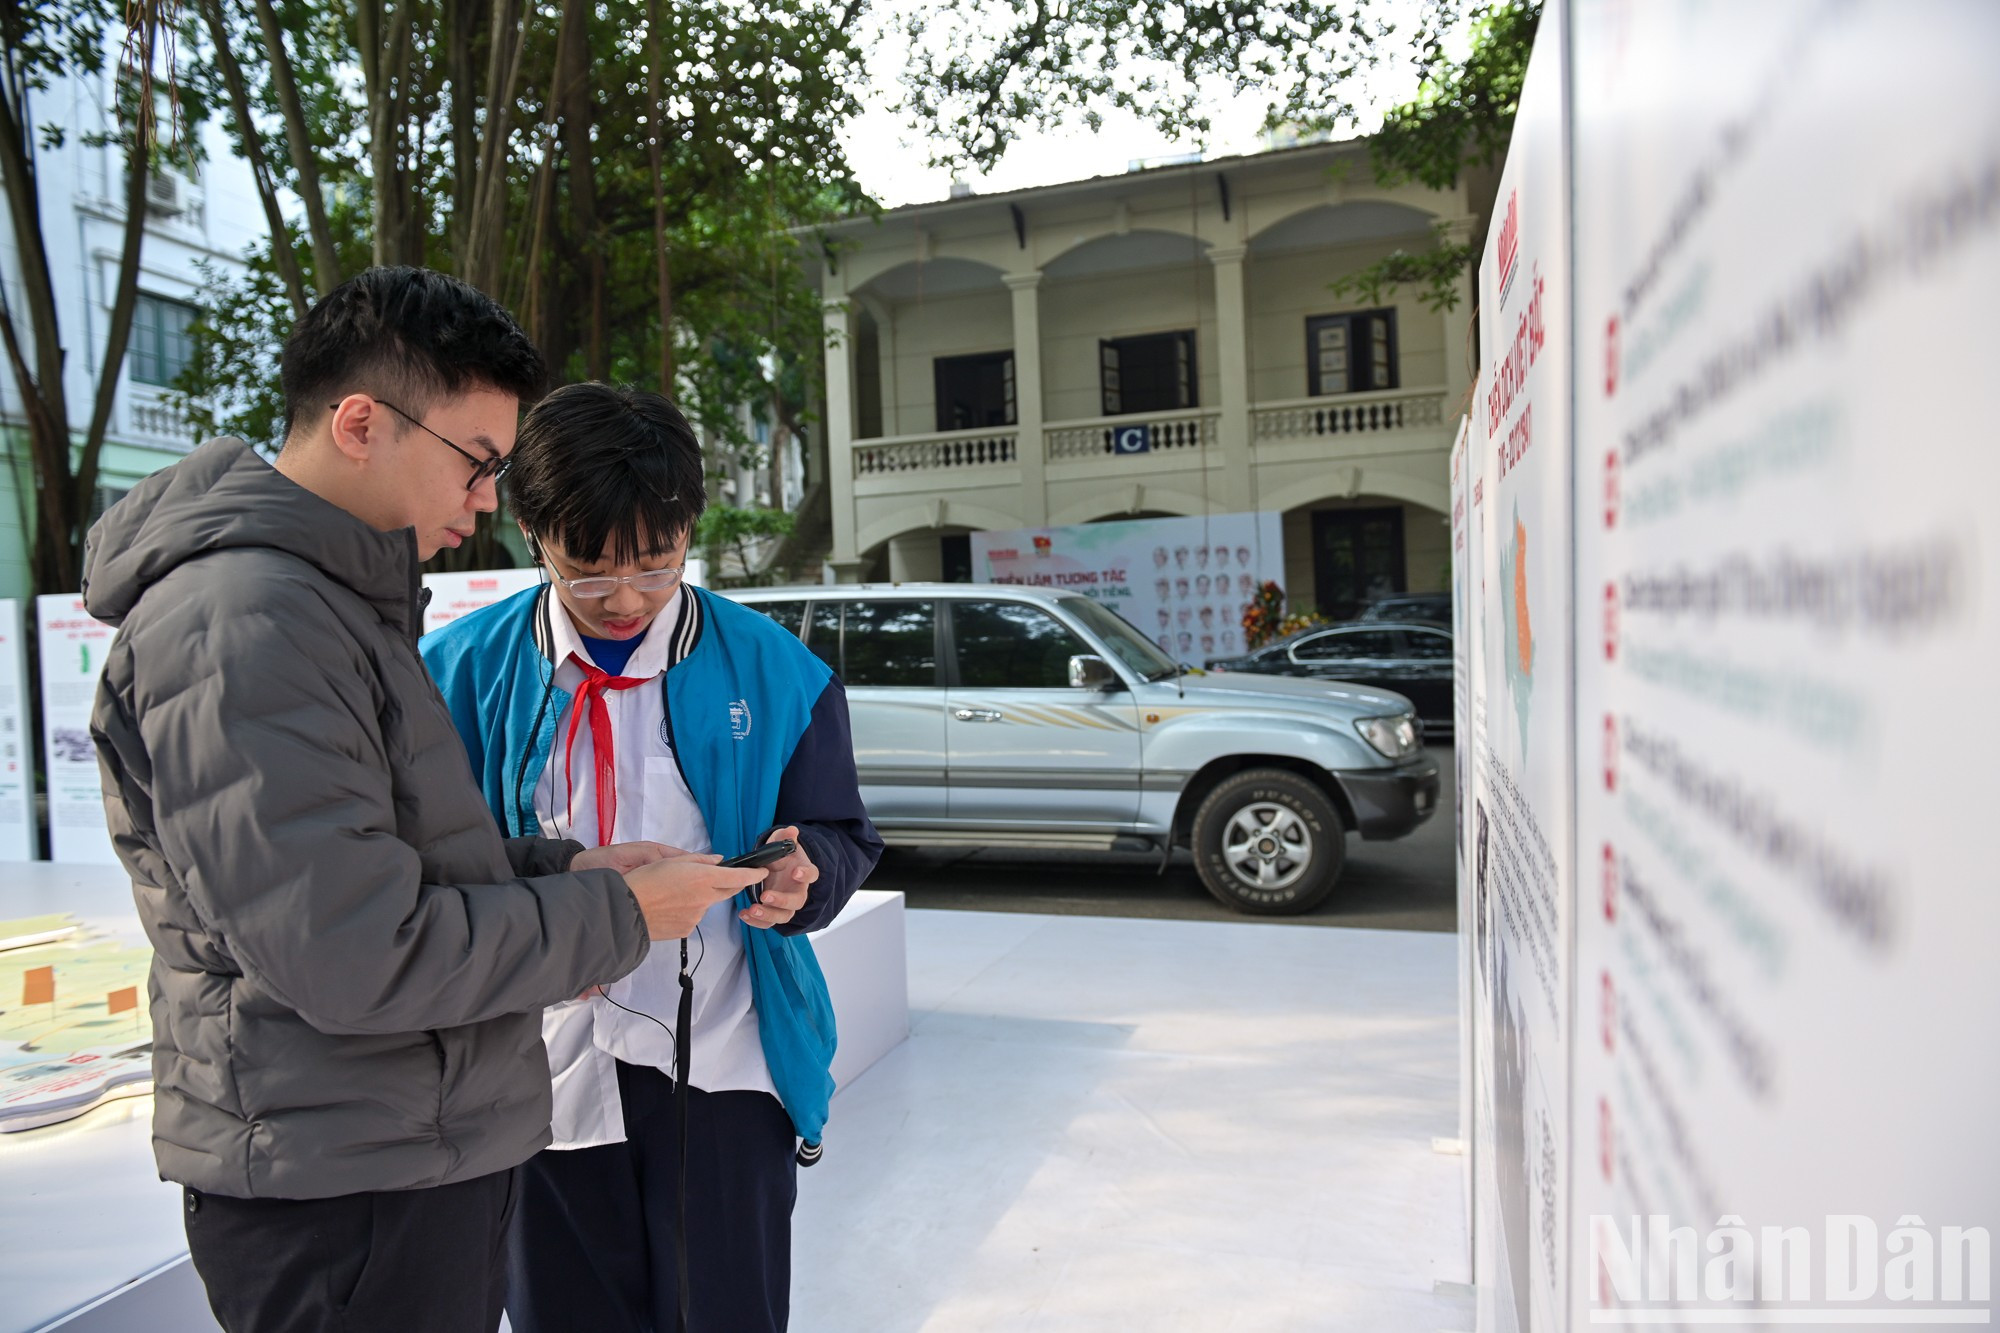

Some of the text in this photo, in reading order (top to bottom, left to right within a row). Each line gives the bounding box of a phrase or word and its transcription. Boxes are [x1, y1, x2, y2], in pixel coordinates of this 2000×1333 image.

[1120, 428, 1142, 452] C
[1102, 568, 1126, 583] TÁC
[1253, 790, 1321, 832] DUNLOP
